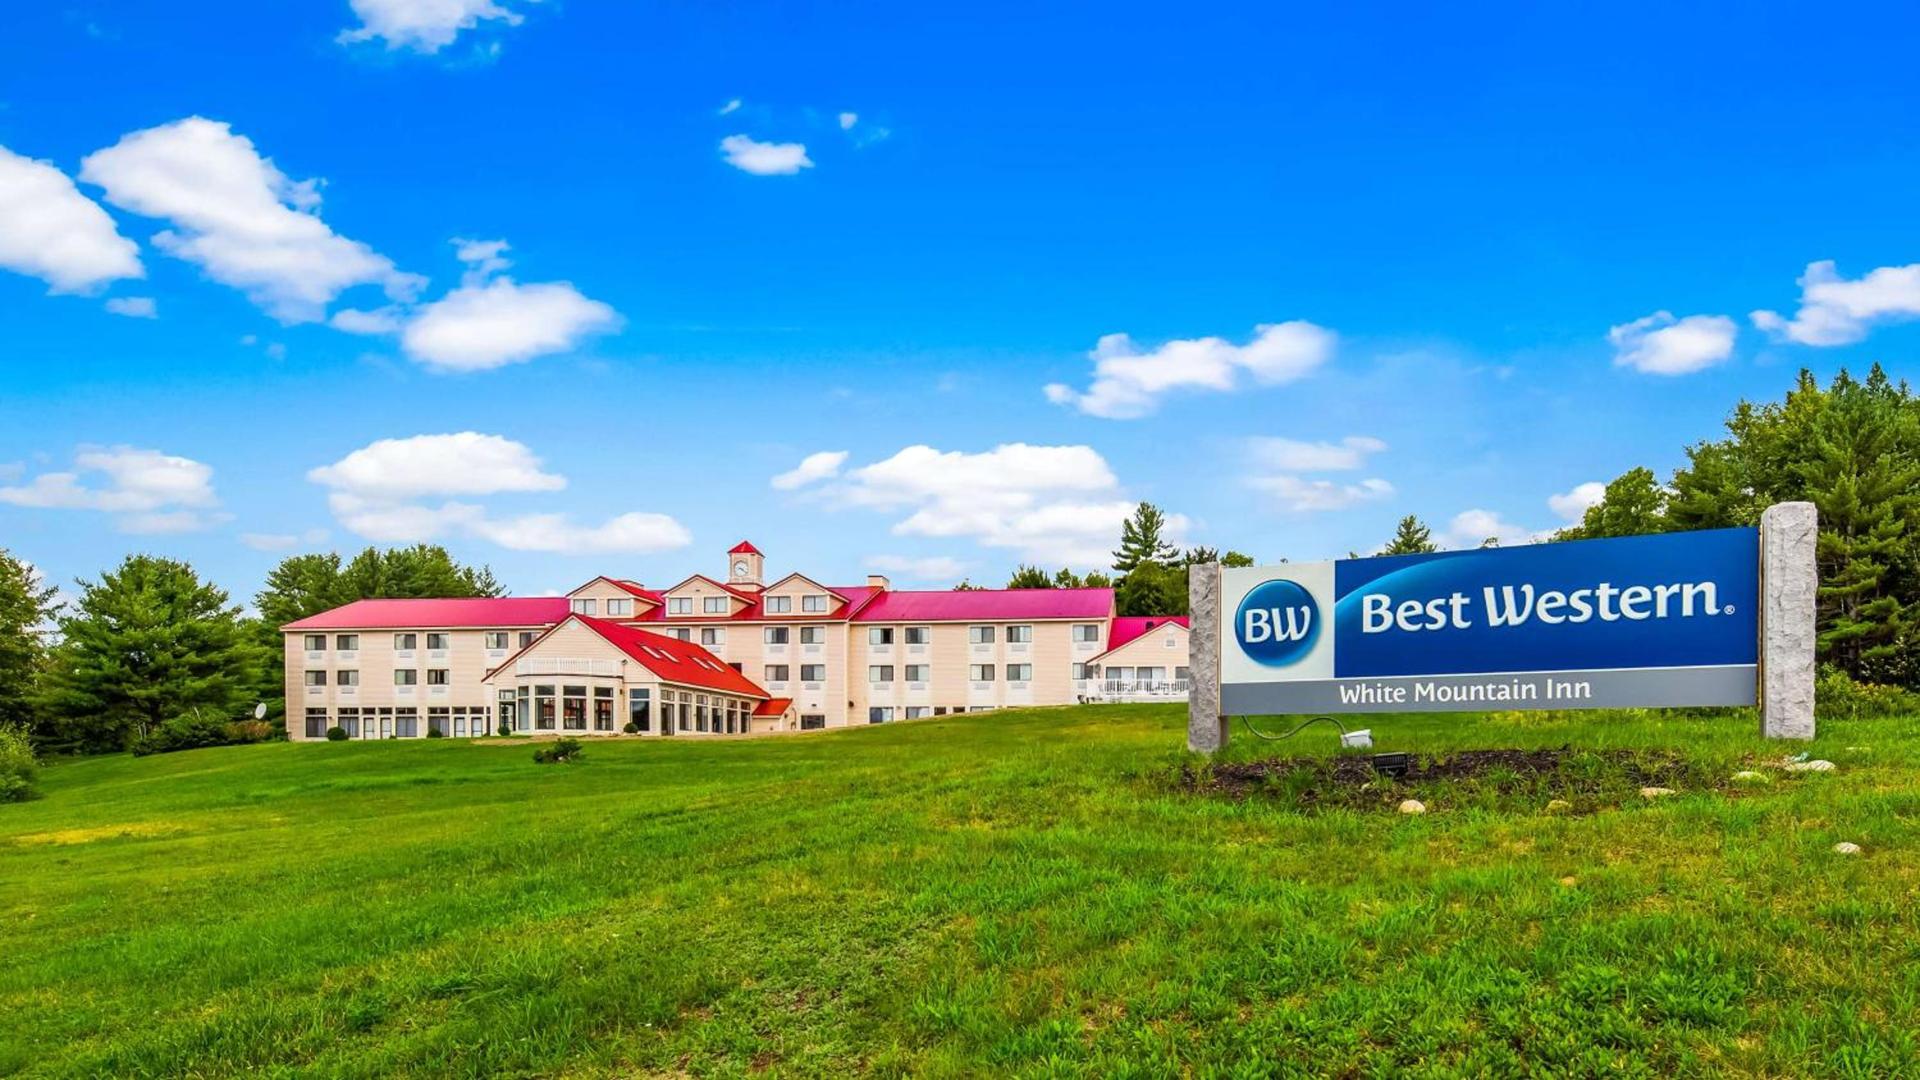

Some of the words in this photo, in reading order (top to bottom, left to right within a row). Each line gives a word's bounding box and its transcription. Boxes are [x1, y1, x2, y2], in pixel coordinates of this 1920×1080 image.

[1244, 605, 1312, 644] BW
[1362, 592, 1472, 634] Best
[1339, 683, 1406, 704] White
[1414, 678, 1537, 702] Mountain
[1546, 679, 1592, 699] Inn
